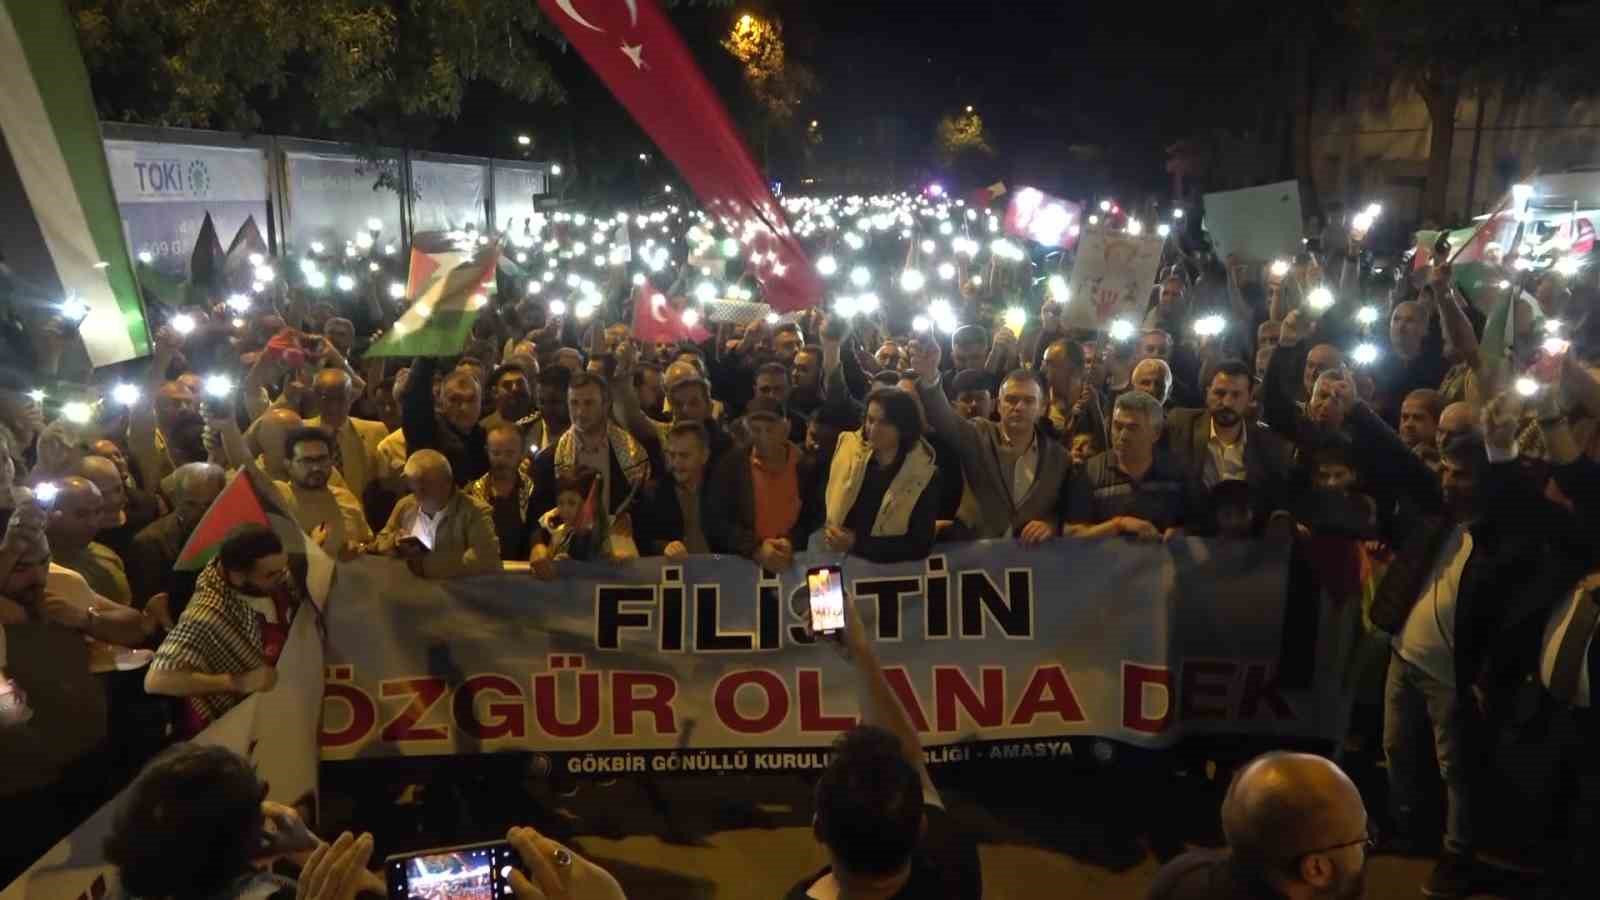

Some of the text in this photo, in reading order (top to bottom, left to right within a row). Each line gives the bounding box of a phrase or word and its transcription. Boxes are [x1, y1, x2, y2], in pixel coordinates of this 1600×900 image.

[317, 653, 680, 749] ÖZGÜR
[1120, 658, 1298, 736] DEK
[567, 752, 646, 773] GÖKBİR
[651, 750, 748, 771] GÖNÜLLÜ
[989, 742, 1073, 760] AMASYA
